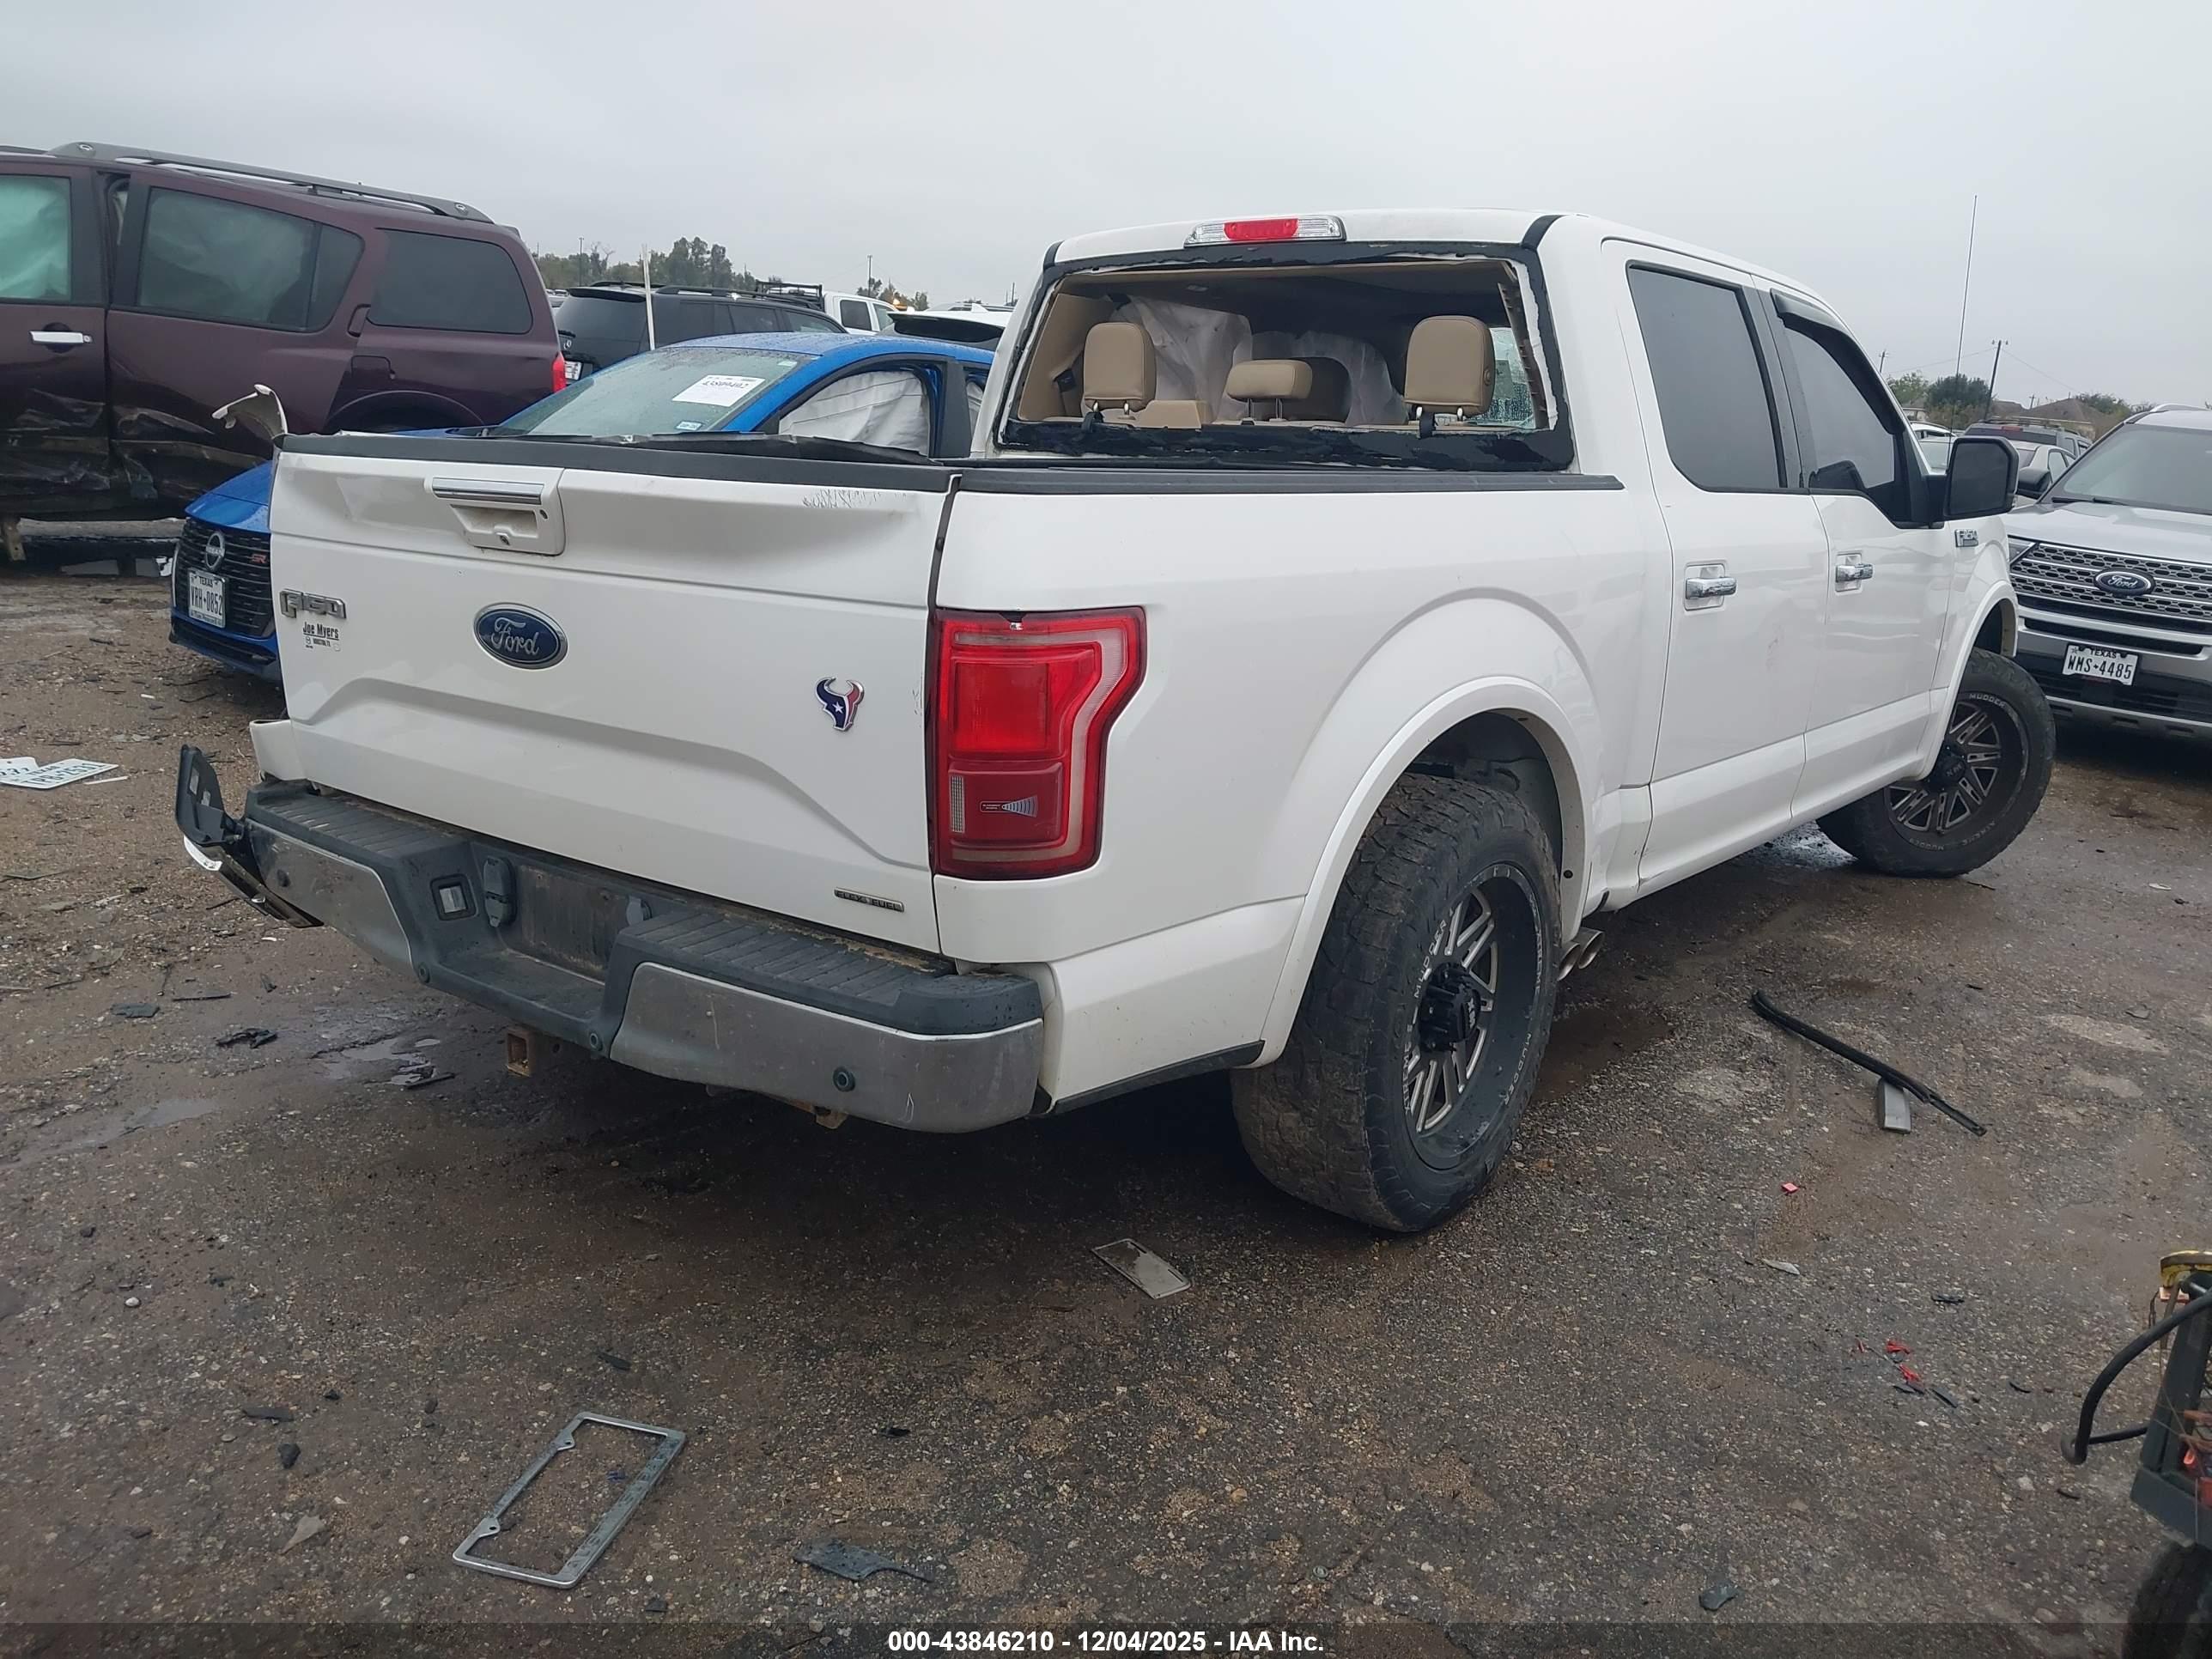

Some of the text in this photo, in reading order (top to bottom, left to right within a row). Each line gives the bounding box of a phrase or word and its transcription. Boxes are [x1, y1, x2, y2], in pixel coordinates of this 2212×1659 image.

[2107, 574, 2138, 588] Ford
[302, 621, 339, 639] Joe Myers
[491, 617, 540, 655] Ford
[2089, 648, 2117, 659] TEXAS
[1413, 920, 1447, 999] MUDDER
[1402, 1041, 1413, 1115] XTREME
[1504, 1033, 1532, 1105] MUDDER
